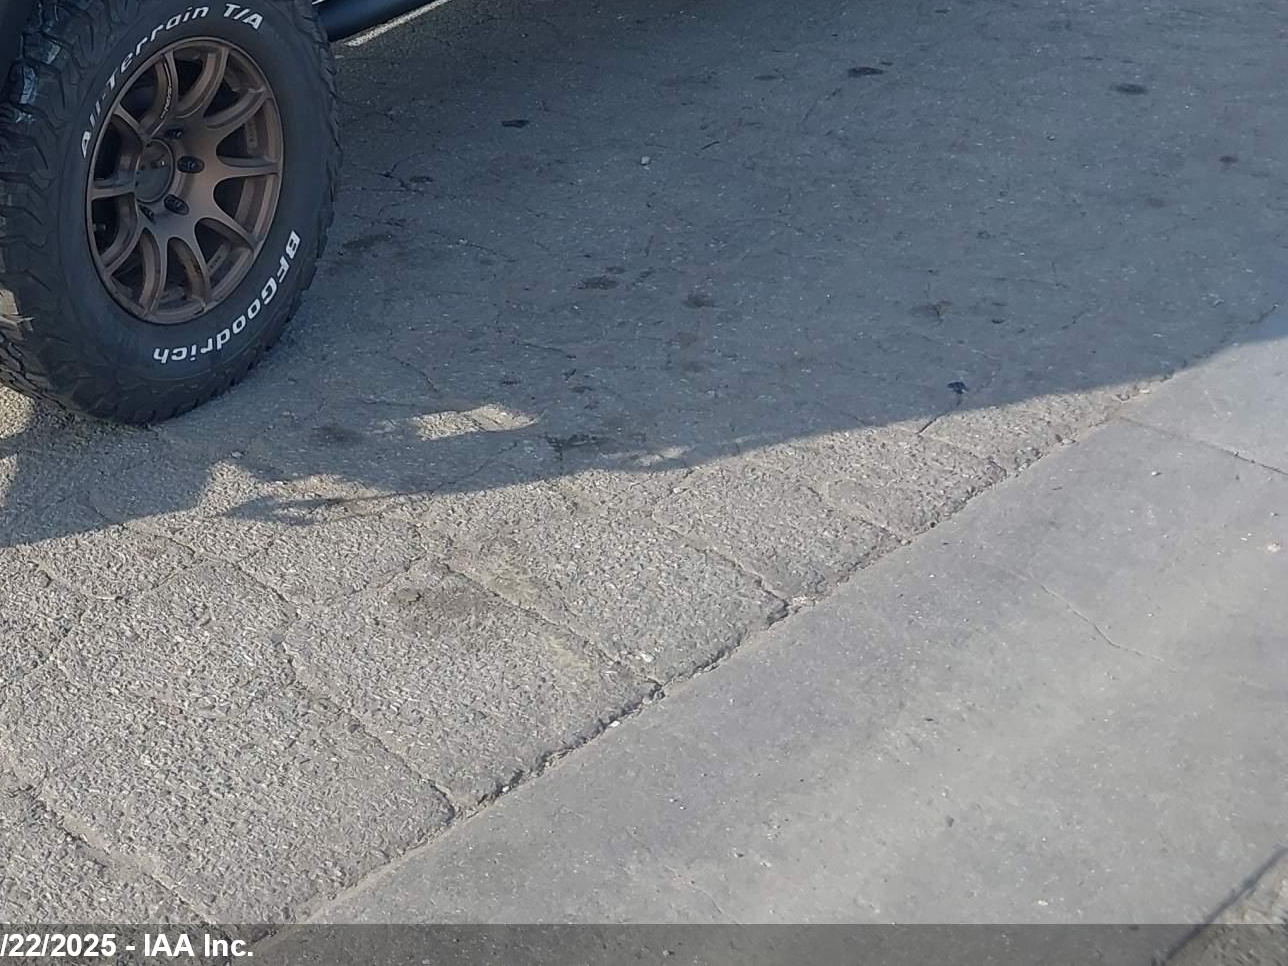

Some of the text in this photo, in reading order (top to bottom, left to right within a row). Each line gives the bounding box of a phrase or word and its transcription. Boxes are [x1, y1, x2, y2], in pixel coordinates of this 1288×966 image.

[81, 2, 264, 159] All-Terrain T/A
[152, 230, 301, 364] BFGoodrich
